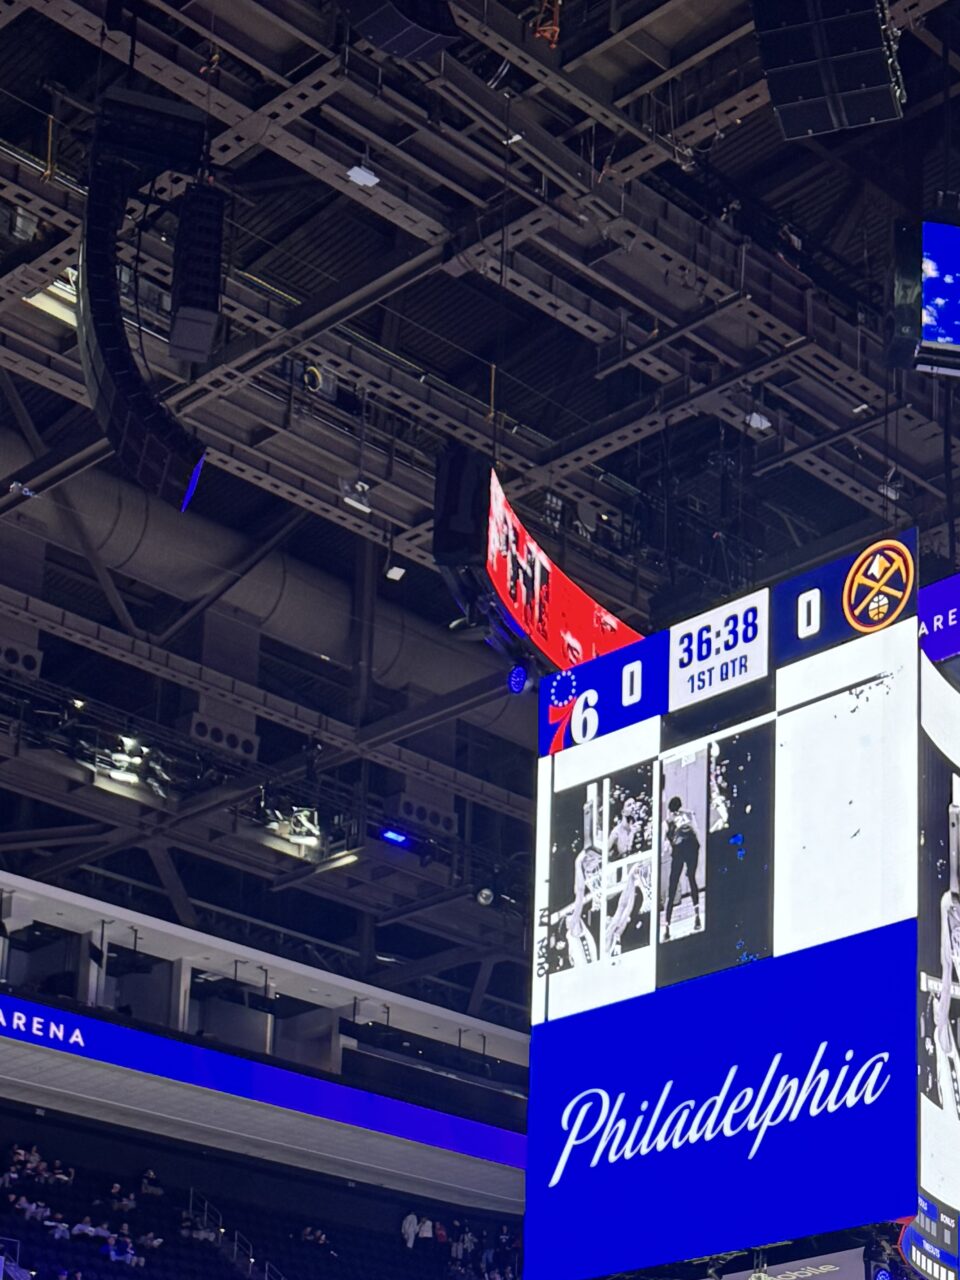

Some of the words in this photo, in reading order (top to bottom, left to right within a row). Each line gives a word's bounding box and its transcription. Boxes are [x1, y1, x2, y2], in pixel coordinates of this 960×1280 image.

[678, 605, 759, 669] 36:38
[797, 588, 820, 639] 0
[622, 660, 643, 707] 0
[688, 664, 716, 694] 1ST
[720, 655, 748, 682] QTR
[548, 1041, 890, 1188] Philadelphia
